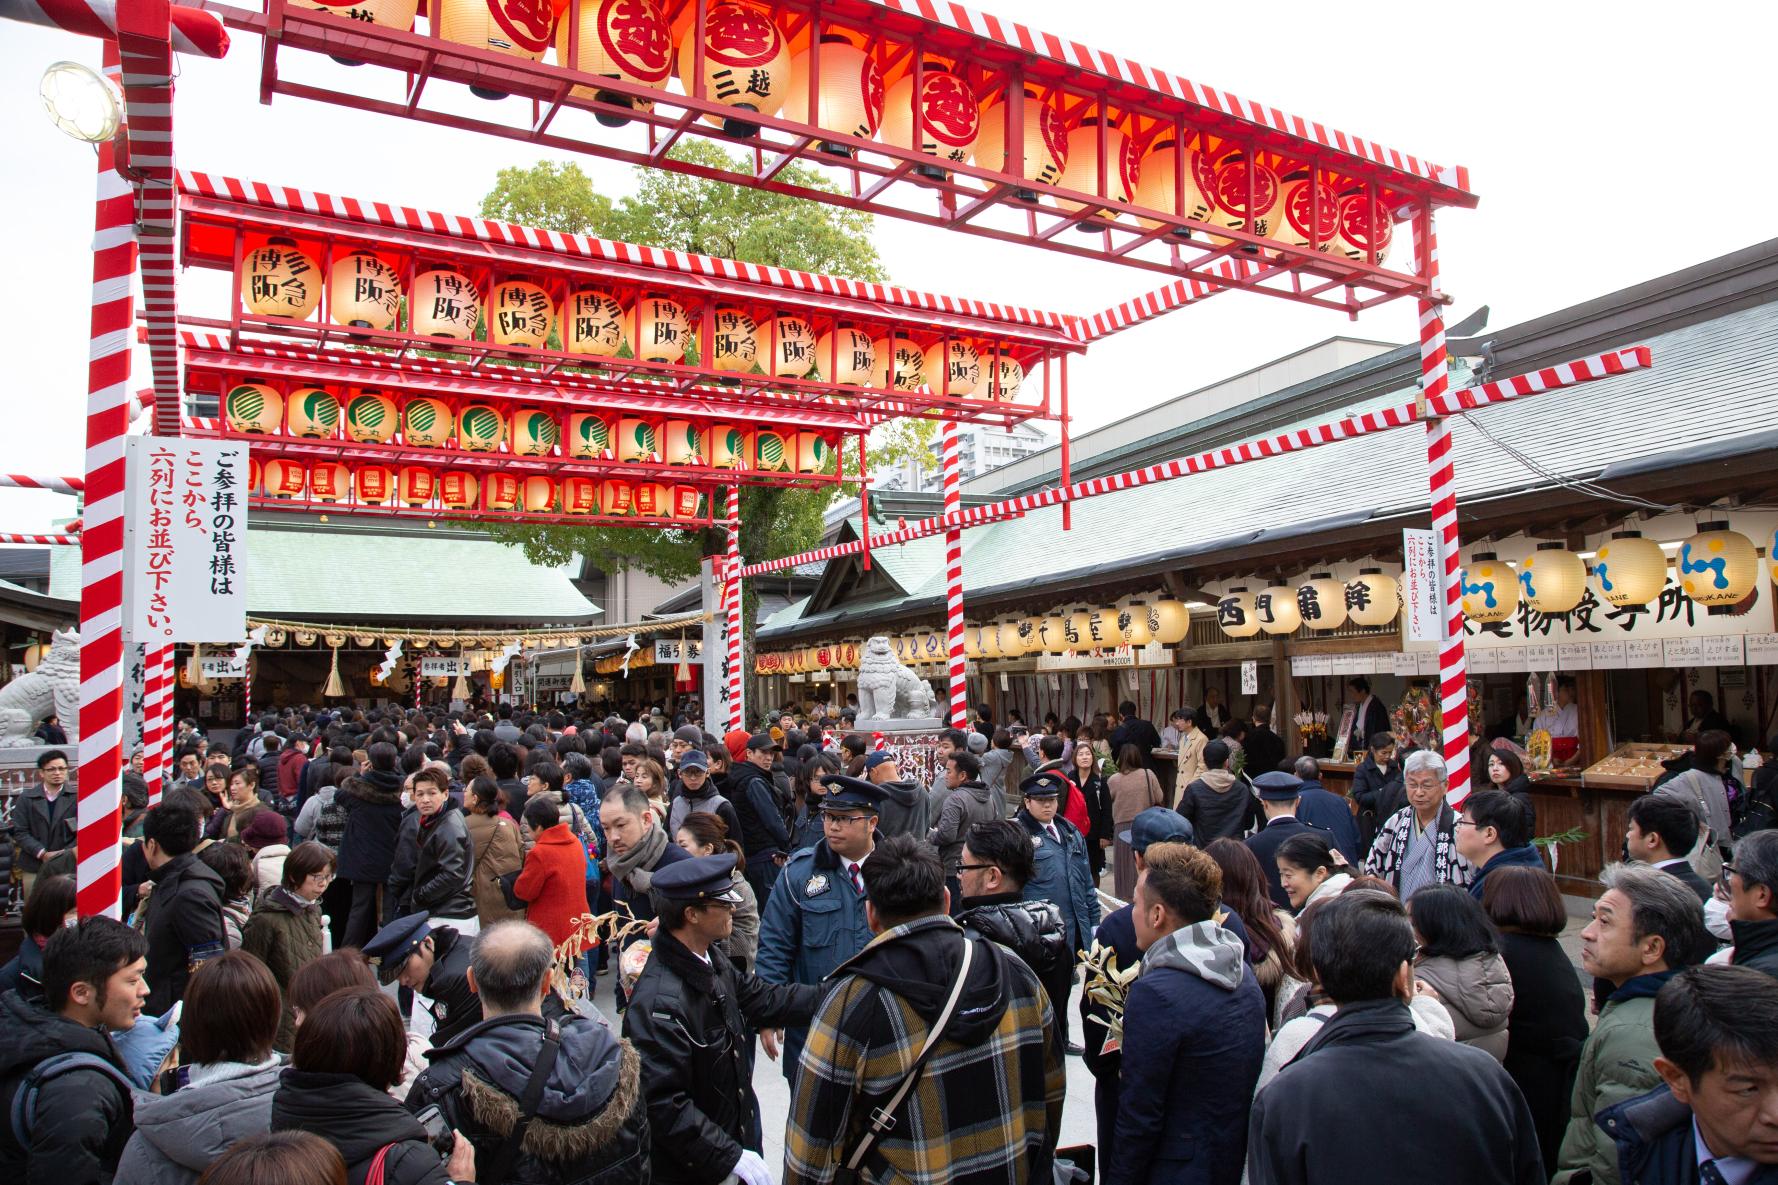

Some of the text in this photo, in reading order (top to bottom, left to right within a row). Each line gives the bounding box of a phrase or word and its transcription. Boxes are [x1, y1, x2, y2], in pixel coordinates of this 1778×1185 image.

[711, 69, 772, 99] 三越
[252, 247, 311, 276] 博多
[355, 256, 401, 288] 博多
[252, 275, 307, 308] 阪急
[355, 277, 399, 316] 阪急
[433, 274, 479, 302] 博多
[501, 287, 549, 313] 博多
[432, 297, 478, 330] 阪急
[577, 294, 622, 319] 博多
[498, 311, 548, 337] 阪急
[576, 317, 621, 348] 阪急
[714, 311, 758, 335] 博多
[714, 333, 757, 362] 阪急
[408, 433, 435, 444] 大丸
[182, 450, 207, 535] ここから、
[209, 450, 239, 596] ご参拝の皆様は
[146, 447, 177, 637] 六列にお並び下さい。
[1418, 536, 1428, 583] ここから、
[1408, 534, 1422, 638] 六列にお並び下さい。
[1427, 535, 1438, 616] ご参拝の皆様は
